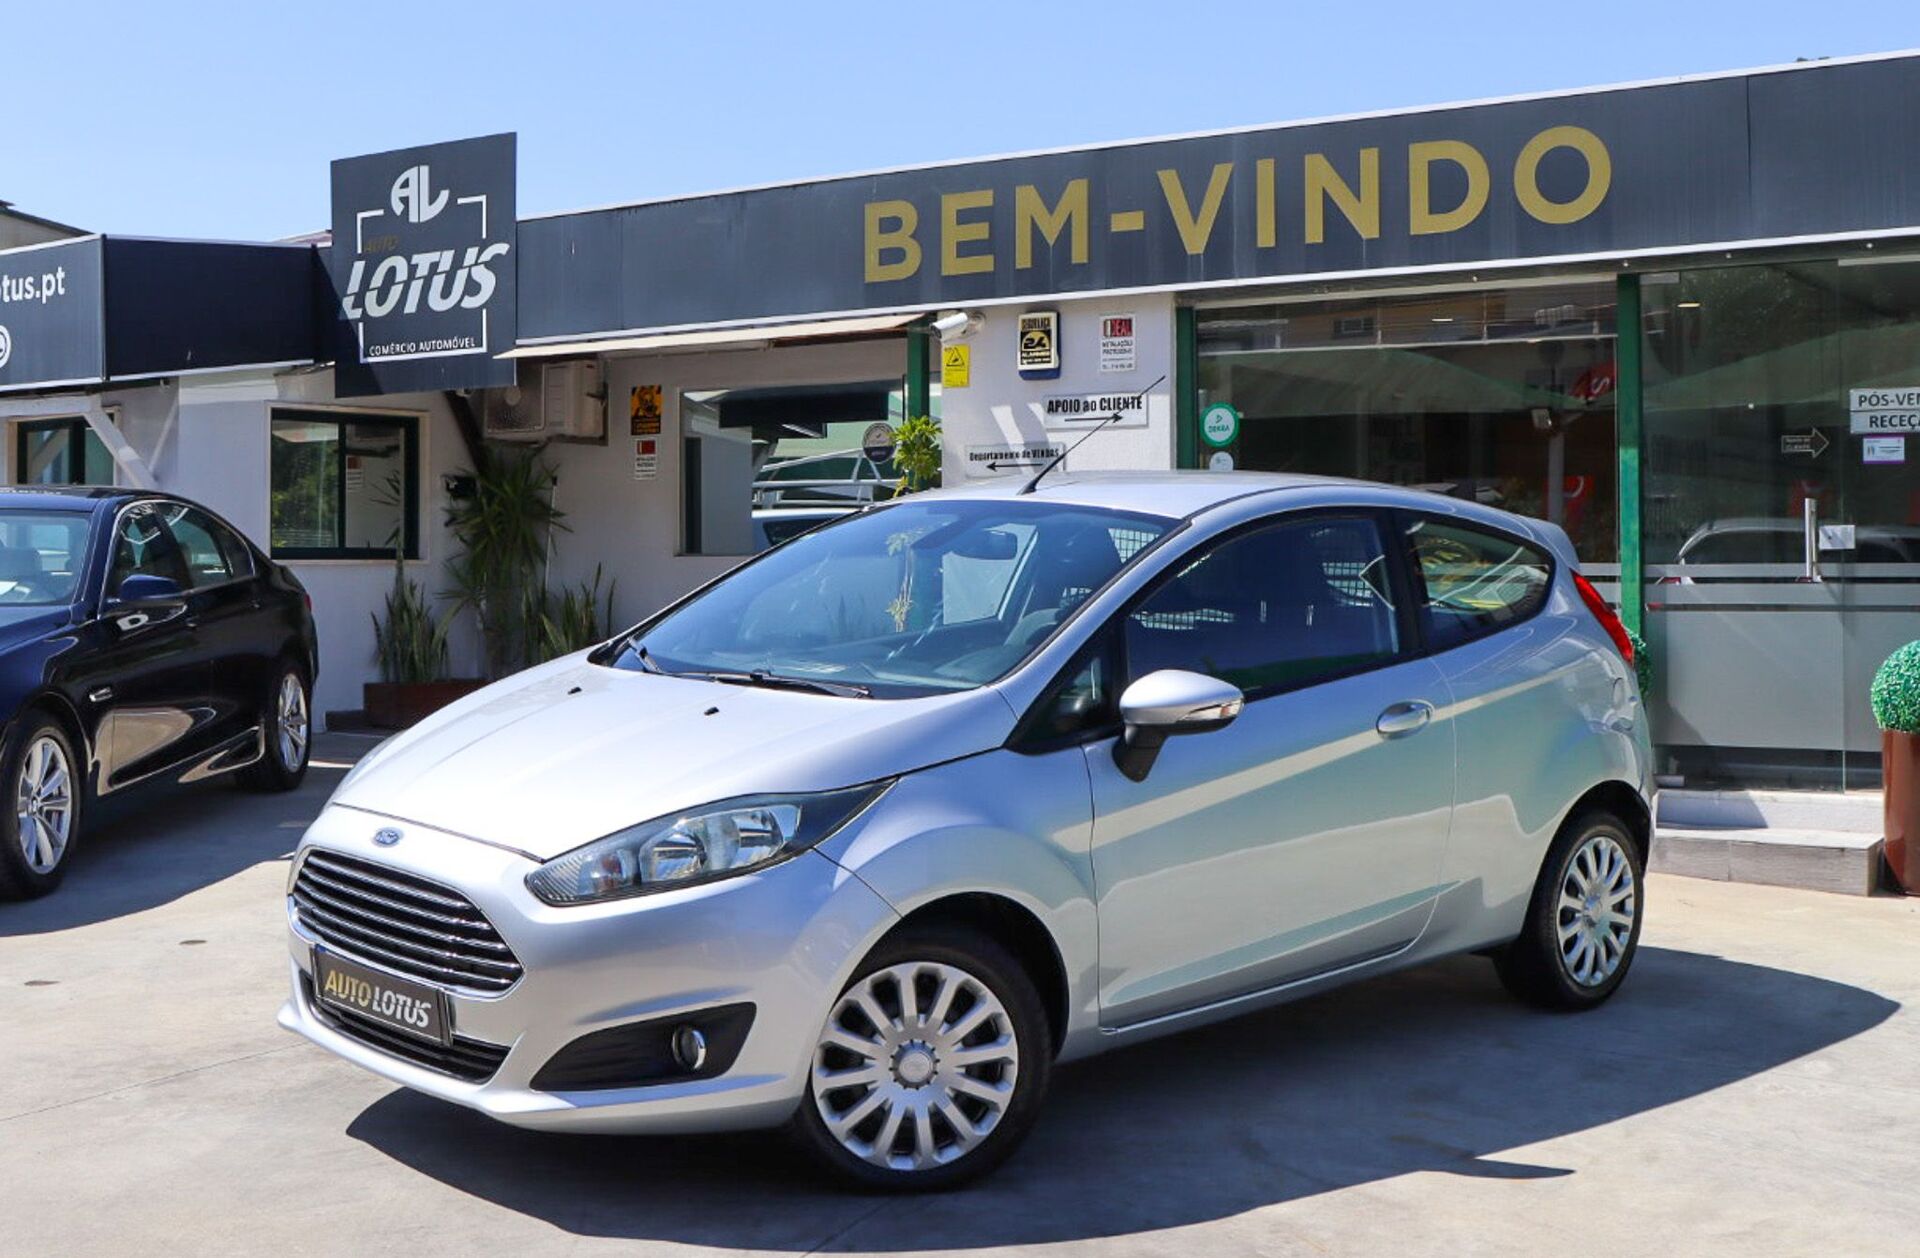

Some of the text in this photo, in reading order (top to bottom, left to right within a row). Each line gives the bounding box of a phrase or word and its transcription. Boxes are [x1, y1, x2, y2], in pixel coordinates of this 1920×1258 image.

[865, 126, 1611, 284] BEM-VINDO
[341, 242, 510, 320] LOTUS
[369, 336, 476, 357] COMÉRCIO AUTOMÓVEL
[1047, 395, 1142, 413] APOIO ao CLIENTE
[1869, 414, 1920, 430] RECEÇ
[1031, 448, 1059, 458] VENDAS
[325, 969, 432, 1028] AUTO LOTUS
